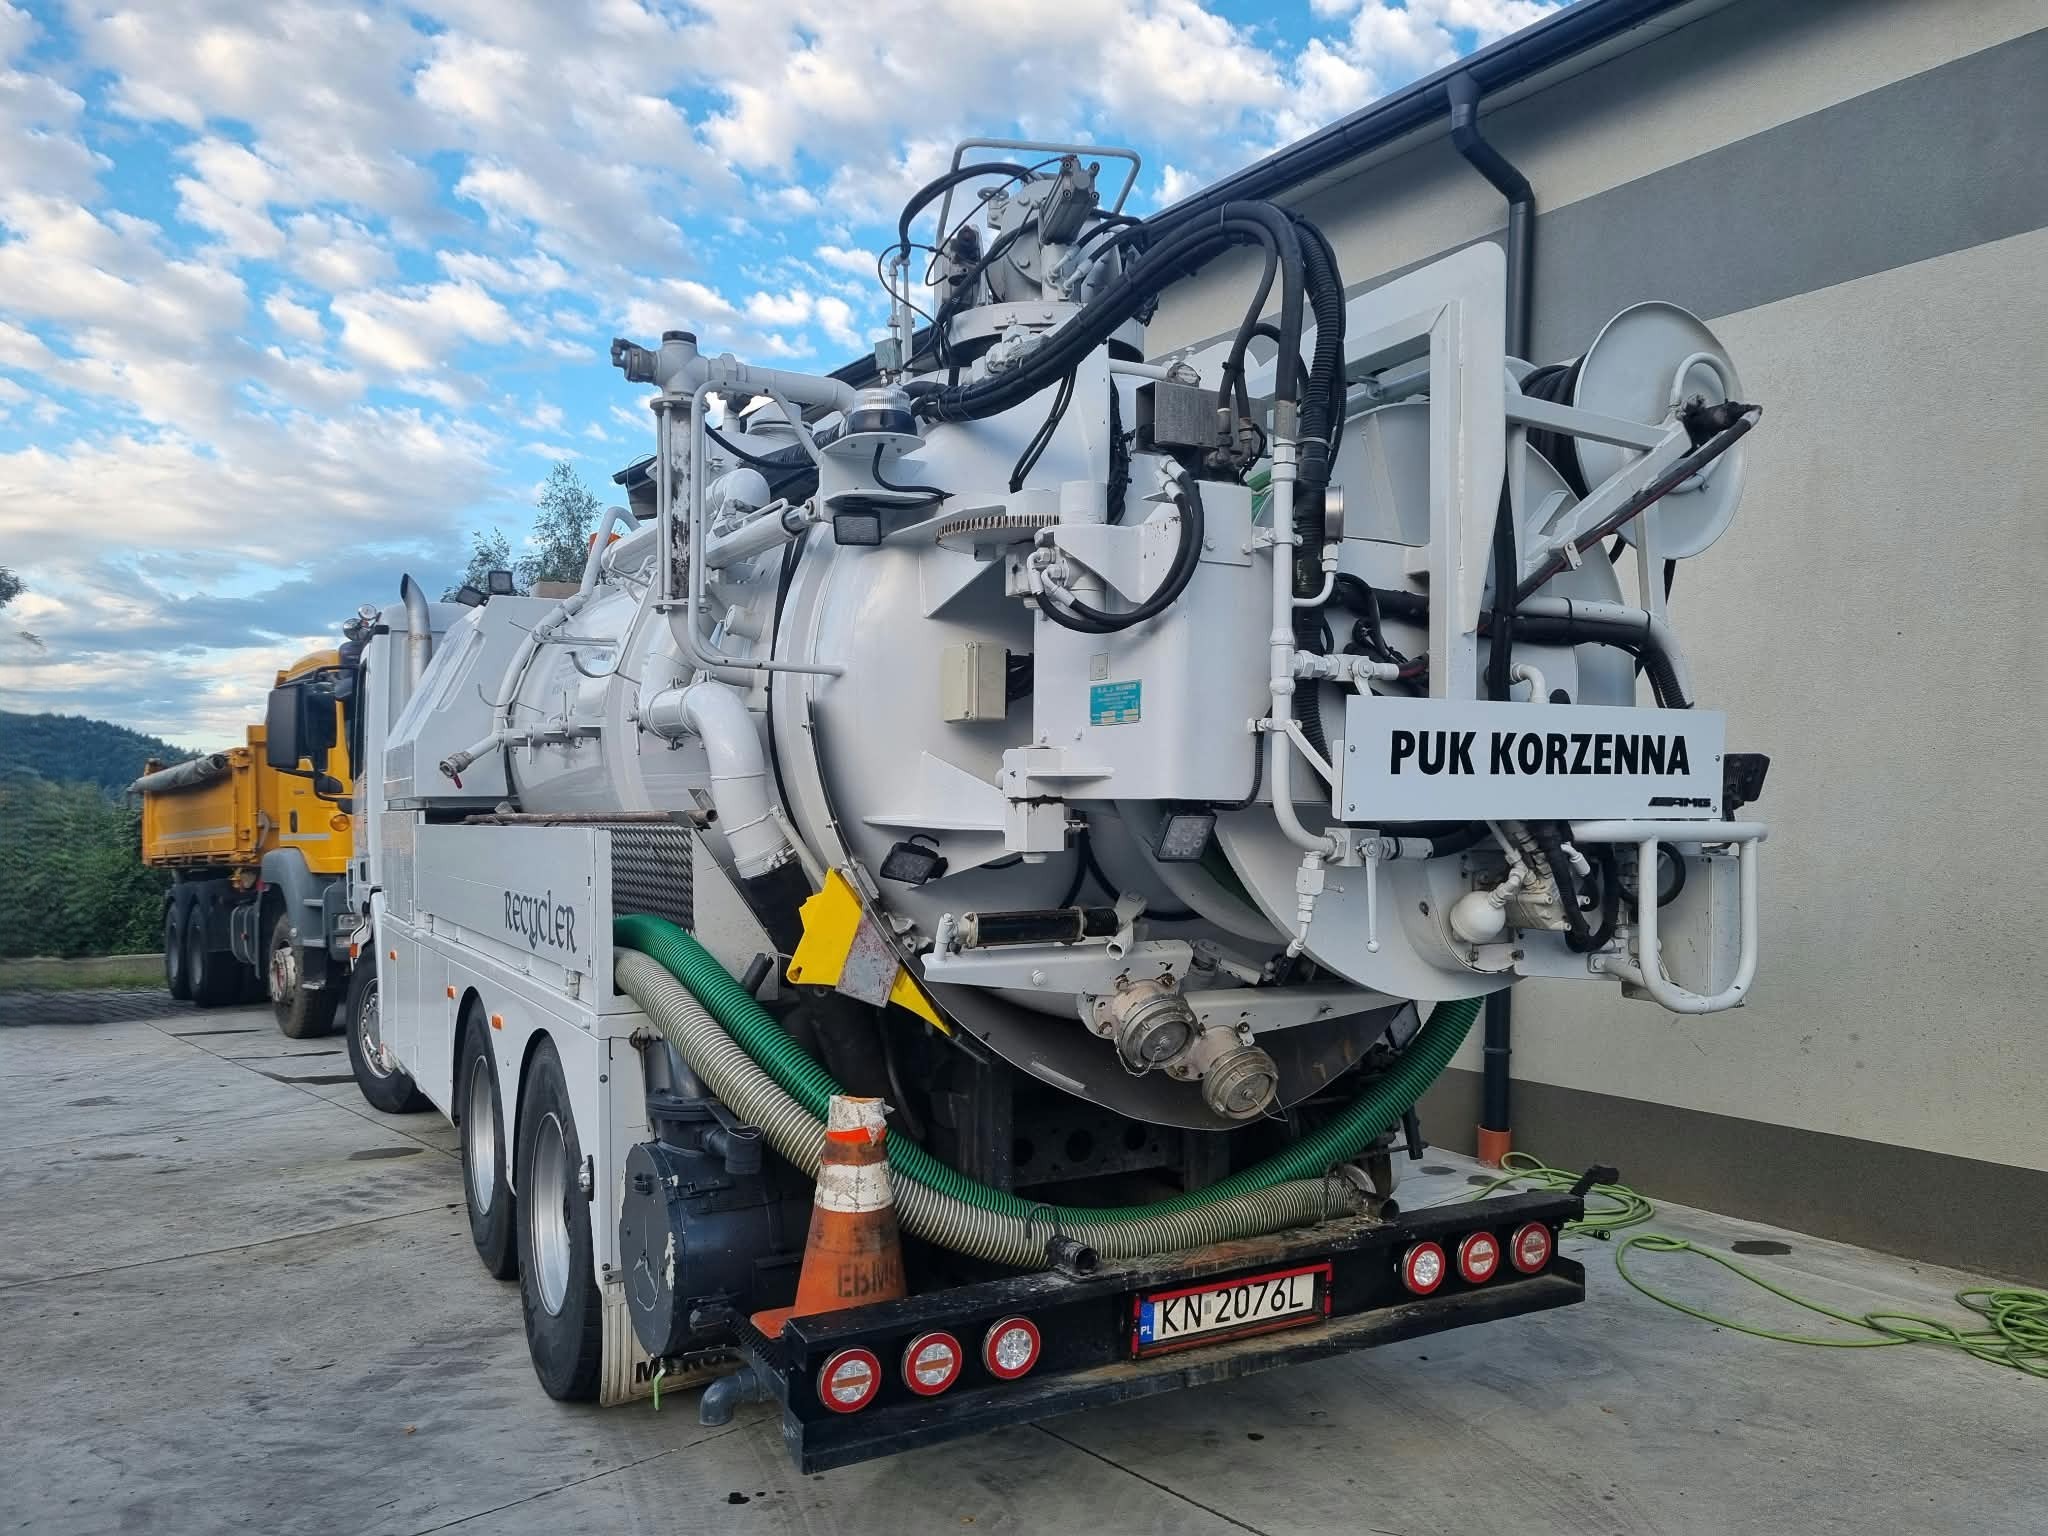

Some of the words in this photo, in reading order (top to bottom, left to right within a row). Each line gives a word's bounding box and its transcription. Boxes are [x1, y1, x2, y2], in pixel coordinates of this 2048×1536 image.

[1390, 730, 1477, 775] PUK
[1490, 732, 1691, 775] KORZENNA
[1669, 797, 1711, 807] AMG
[1161, 1295, 1201, 1335] KN
[1215, 1276, 1304, 1324] 2076L
[1140, 1326, 1152, 1335] PL
